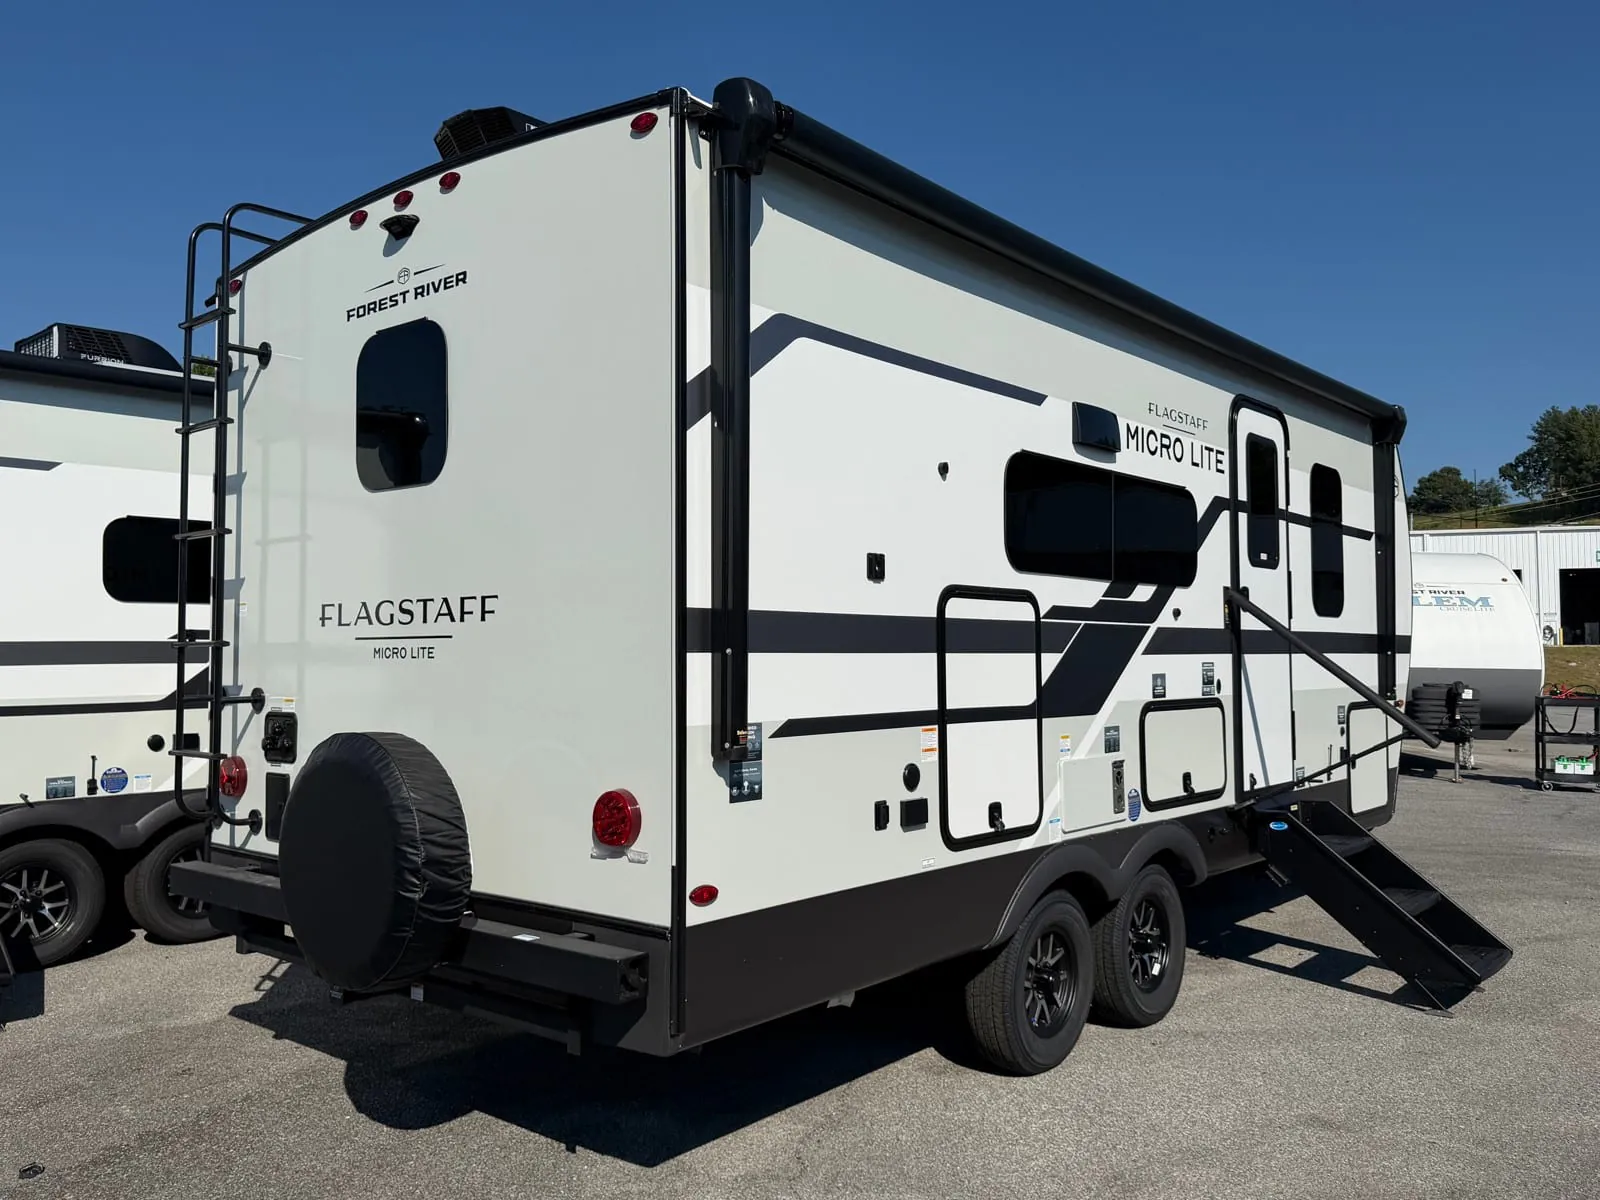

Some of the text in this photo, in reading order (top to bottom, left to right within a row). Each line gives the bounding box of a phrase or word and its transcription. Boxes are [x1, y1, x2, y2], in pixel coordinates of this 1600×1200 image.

[346, 270, 468, 322] FOREST RIVER
[1147, 401, 1209, 431] FLAGSTAFF
[1125, 422, 1225, 475] MICRO LITE
[319, 594, 499, 627] FLAGSTAFF
[1413, 596, 1494, 607] LEM
[373, 646, 435, 660] MICRO LITE
